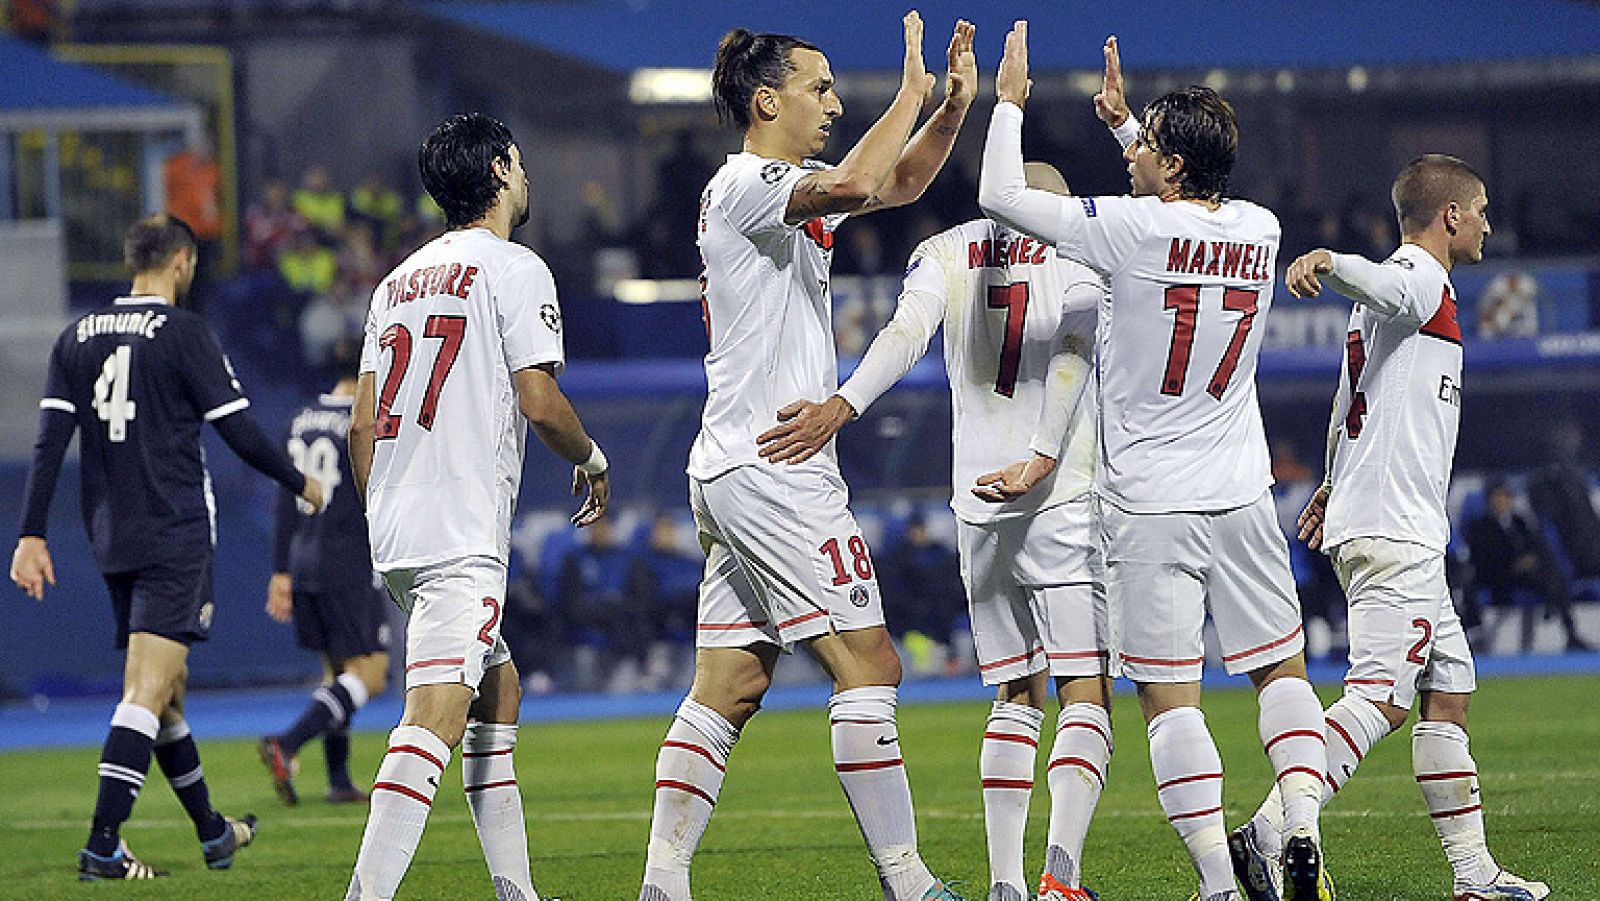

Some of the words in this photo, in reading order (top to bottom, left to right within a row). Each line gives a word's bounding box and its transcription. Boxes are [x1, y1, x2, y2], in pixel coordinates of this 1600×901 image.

[1166, 237, 1270, 280] MAXWELL
[387, 262, 479, 312] PASTORE
[988, 281, 1030, 399] 7
[1160, 285, 1260, 402] 17
[92, 345, 136, 443] 4
[374, 314, 468, 440] 27
[819, 535, 873, 586] 18
[477, 596, 500, 647] 2
[1406, 617, 1432, 665] 2
